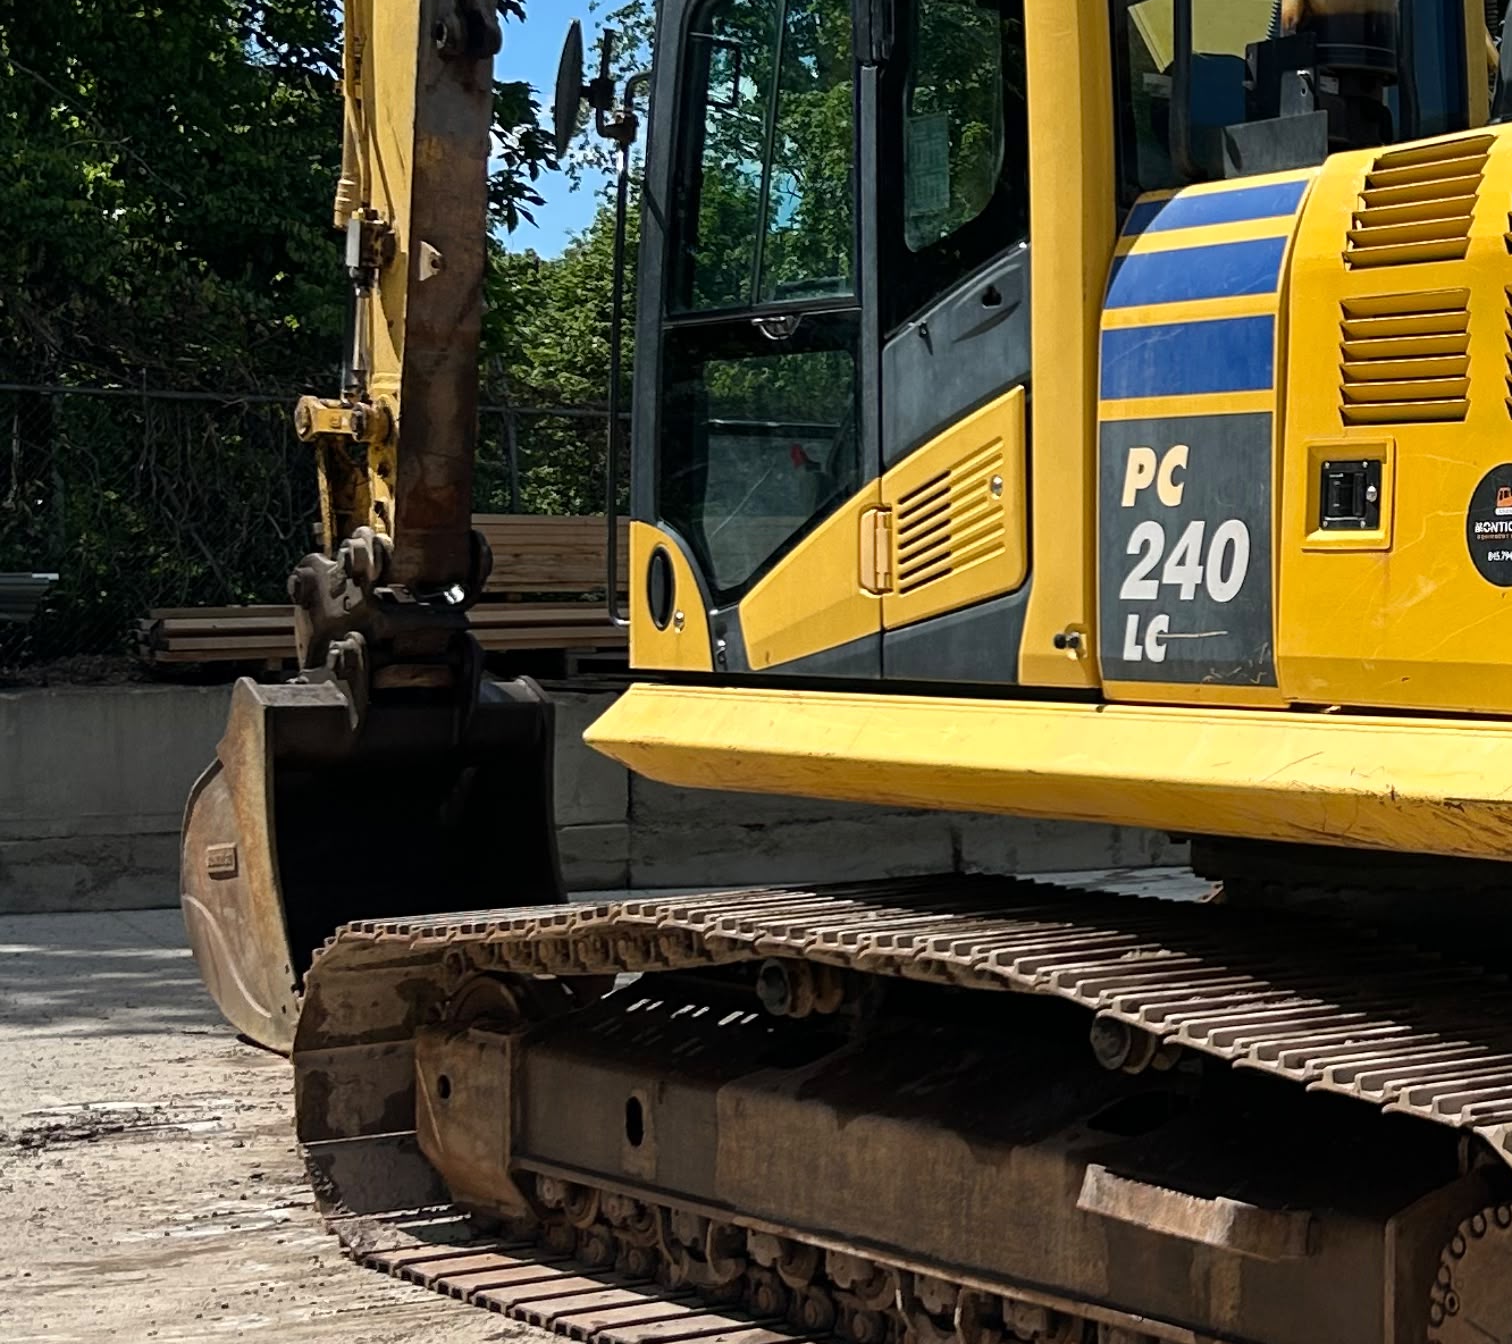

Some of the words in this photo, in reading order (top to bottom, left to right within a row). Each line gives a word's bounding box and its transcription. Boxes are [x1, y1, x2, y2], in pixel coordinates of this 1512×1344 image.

[1121, 444, 1189, 507] PC
[1119, 519, 1251, 602] 240
[1123, 614, 1170, 662] LC
